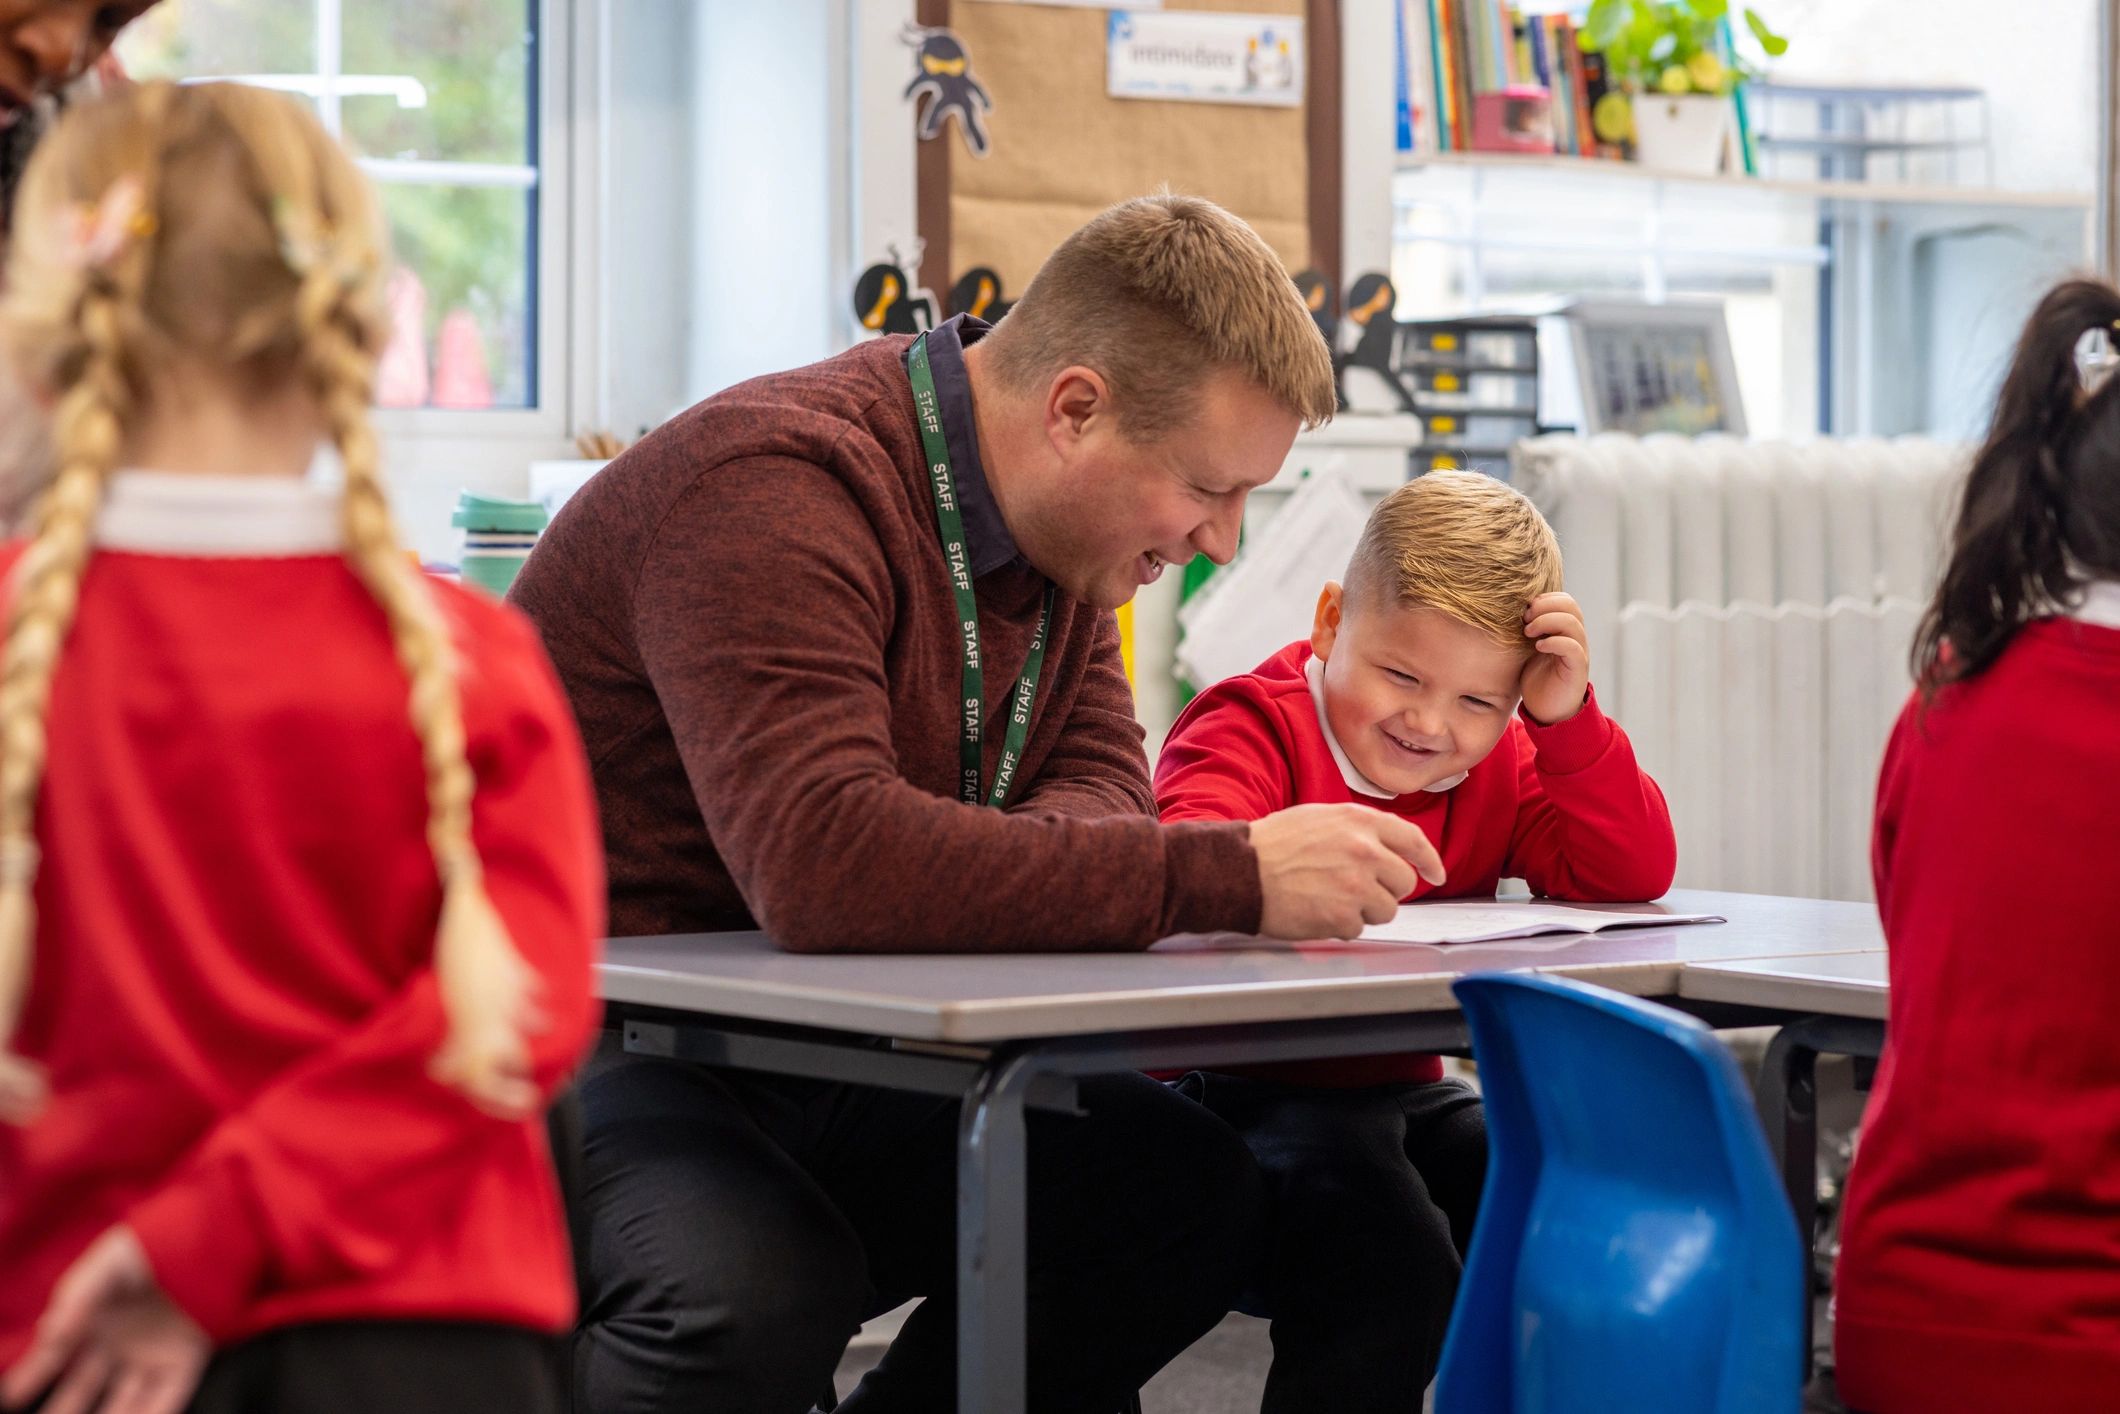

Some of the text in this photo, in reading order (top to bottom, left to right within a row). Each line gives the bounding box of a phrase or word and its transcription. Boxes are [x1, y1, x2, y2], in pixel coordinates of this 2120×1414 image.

[918, 390, 939, 433] STAFF
[933, 463, 954, 511] STAFF
[948, 542, 970, 591] STAFF
[963, 620, 979, 669] STAFF
[965, 698, 979, 744] STAFF
[1014, 676, 1034, 725] STAFF
[994, 751, 1016, 799] STAFF
